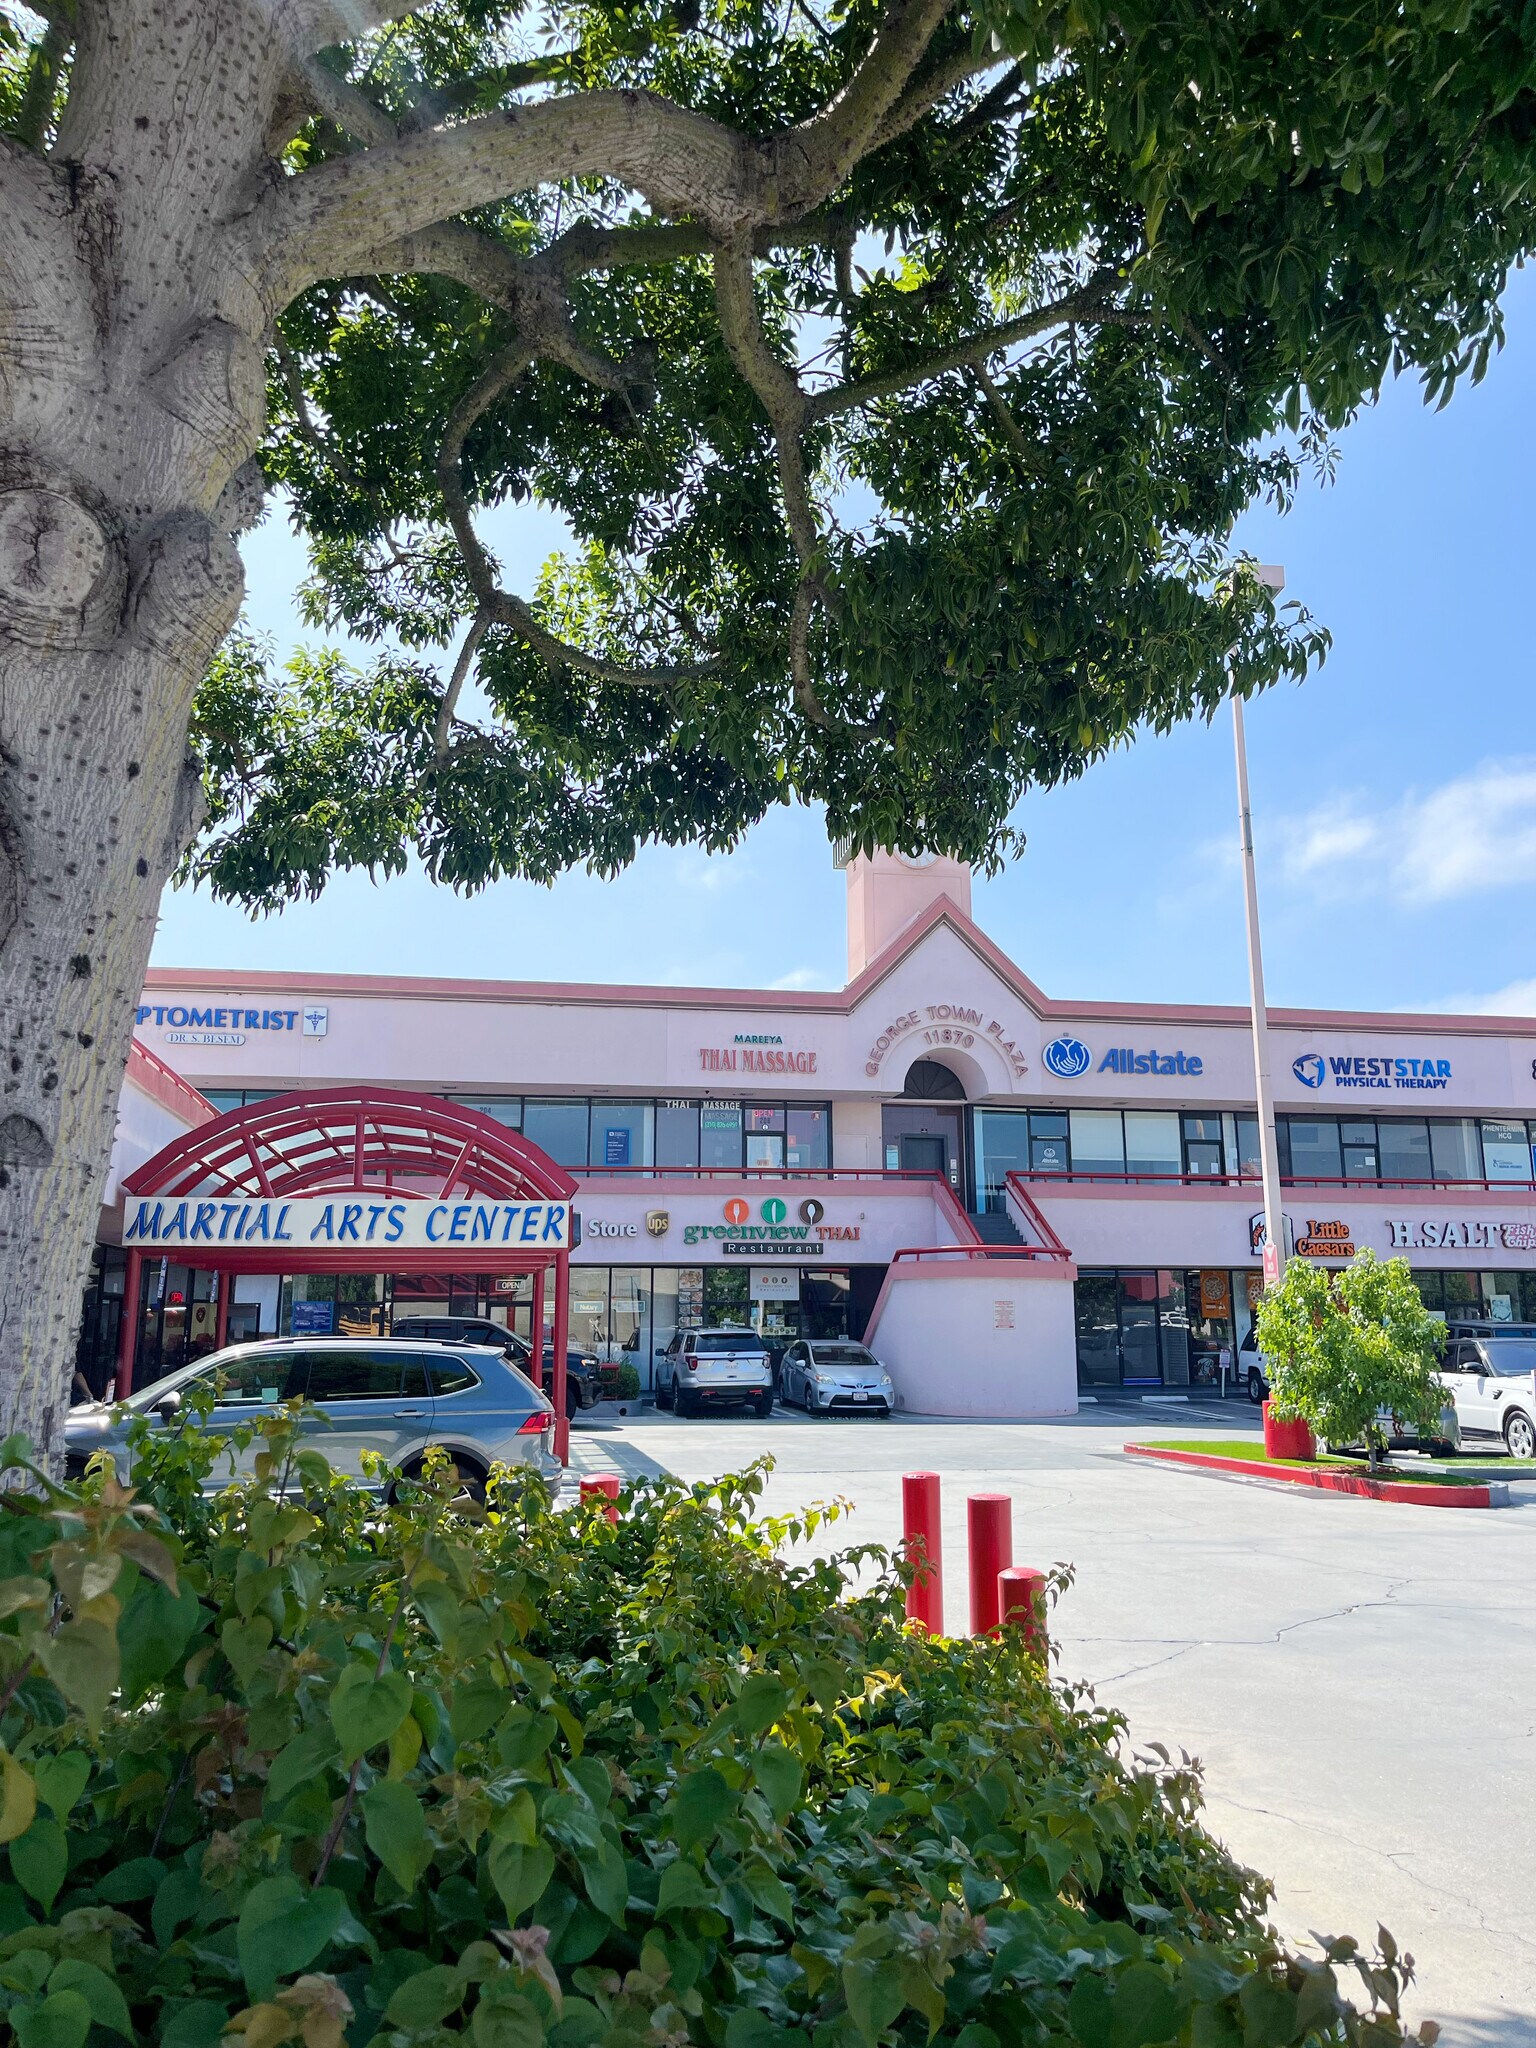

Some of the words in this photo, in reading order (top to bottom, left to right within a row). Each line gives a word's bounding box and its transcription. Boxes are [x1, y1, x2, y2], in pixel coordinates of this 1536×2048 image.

[136, 1005, 298, 1030] PTOMETRIST
[170, 1033, 188, 1043] DR.
[191, 1034, 200, 1043] S.
[203, 1034, 240, 1044] BESEM
[734, 1034, 783, 1044] MAREEYA
[865, 1010, 921, 1077] GEORGE
[926, 1004, 984, 1027] TOWN
[986, 1020, 1029, 1079] PLAZA
[923, 1029, 975, 1049] 11870
[699, 1048, 737, 1071] THAI
[741, 1049, 817, 1074] MASSAGE
[1097, 1048, 1203, 1076] Allstate
[1329, 1057, 1452, 1078] WESTSTAR
[1336, 1076, 1391, 1088] PHYSICAL
[1394, 1078, 1447, 1089] THERAPY
[665, 1100, 690, 1109] THAI
[703, 1101, 740, 1110] MASSAGE
[754, 1109, 774, 1117] OPEN
[125, 1201, 294, 1241] MARTIAL
[309, 1203, 405, 1241] ARTS
[424, 1205, 567, 1242] CENTER
[588, 1218, 638, 1238] Store
[648, 1218, 668, 1234] ups
[1306, 1220, 1349, 1239] Little
[683, 1224, 811, 1245] greenview
[816, 1226, 861, 1241] THAI
[1506, 1236, 1536, 1250] Chip
[727, 1243, 821, 1254] Restaurant
[1296, 1238, 1355, 1256] Caesars
